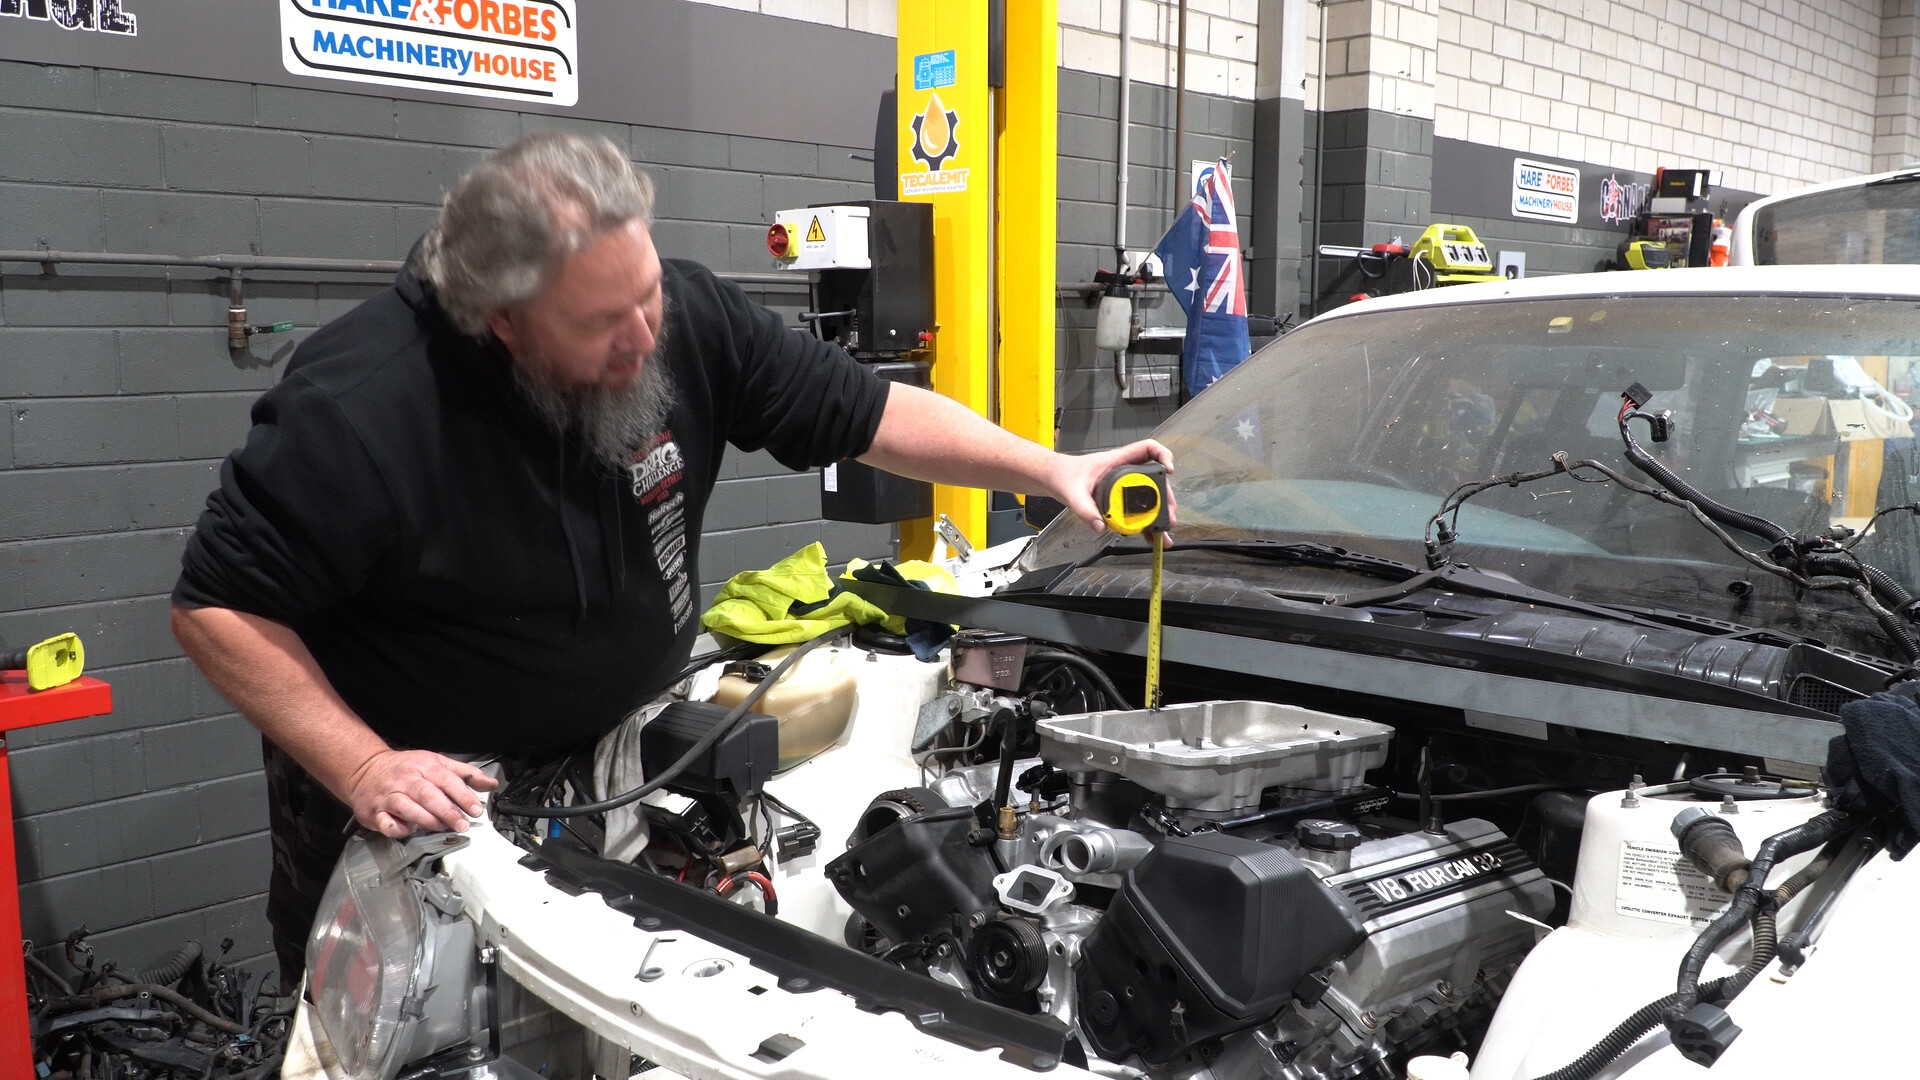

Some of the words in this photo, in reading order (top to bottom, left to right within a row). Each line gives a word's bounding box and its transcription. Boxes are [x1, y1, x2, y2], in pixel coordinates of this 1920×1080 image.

[312, 0, 556, 41] RE&FORBES
[902, 170, 968, 188] TECALEMIT
[631, 441, 681, 484] DRAG
[633, 458, 684, 497] CHALLENGE
[1366, 877, 1407, 902] V8
[1404, 863, 1451, 892] FOUR
[1447, 858, 1480, 880] CAM
